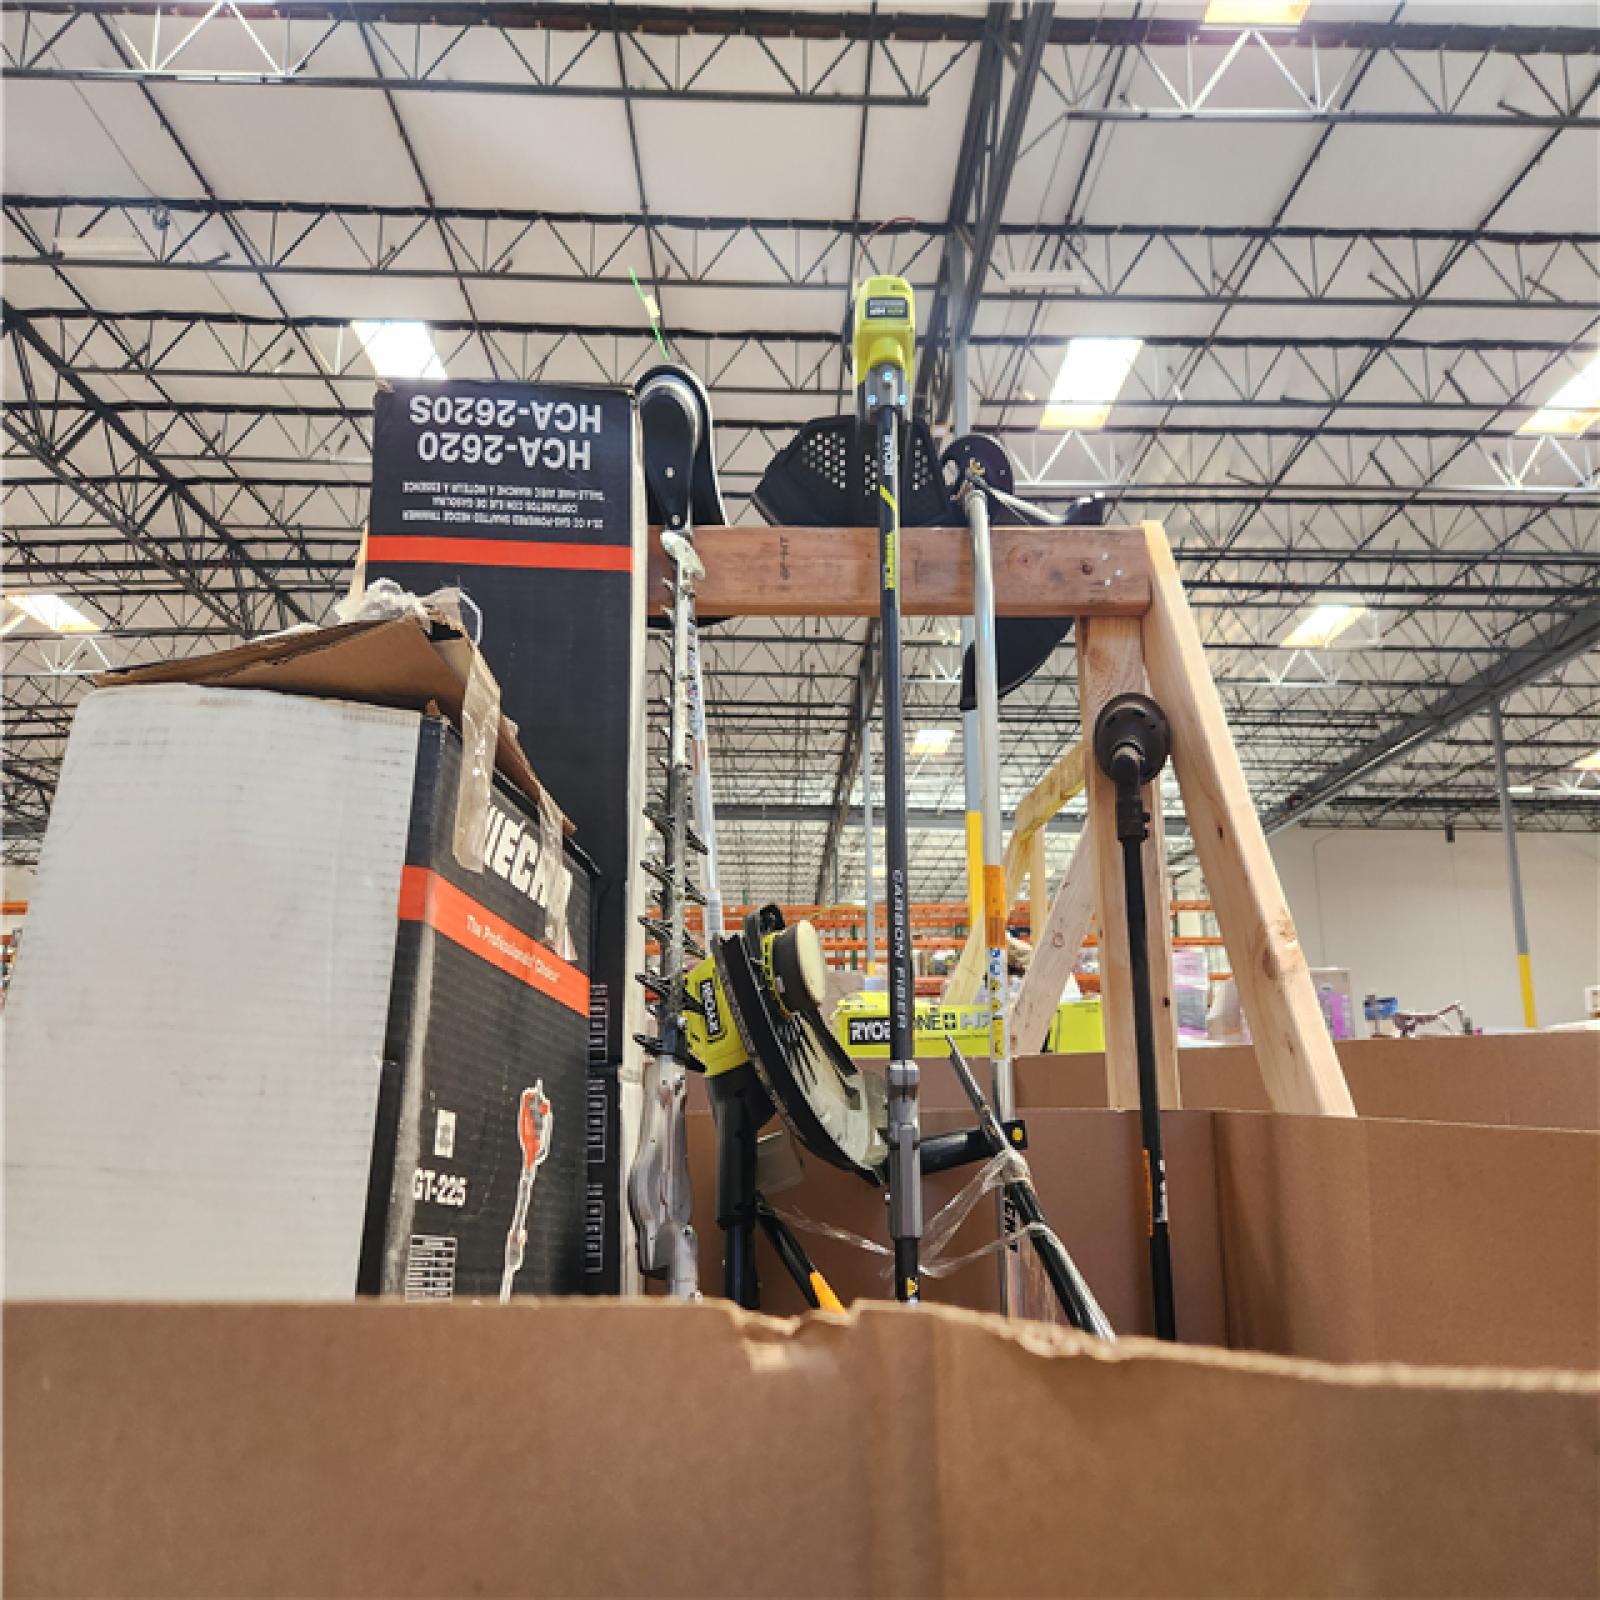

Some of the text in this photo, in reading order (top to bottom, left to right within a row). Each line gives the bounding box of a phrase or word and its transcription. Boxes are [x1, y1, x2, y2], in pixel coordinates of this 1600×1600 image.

[409, 394, 601, 433] HCA-2620S
[417, 430, 591, 471] HCA-2620
[850, 1017, 890, 1041] RYO
[413, 1168, 467, 1207] GT-225
